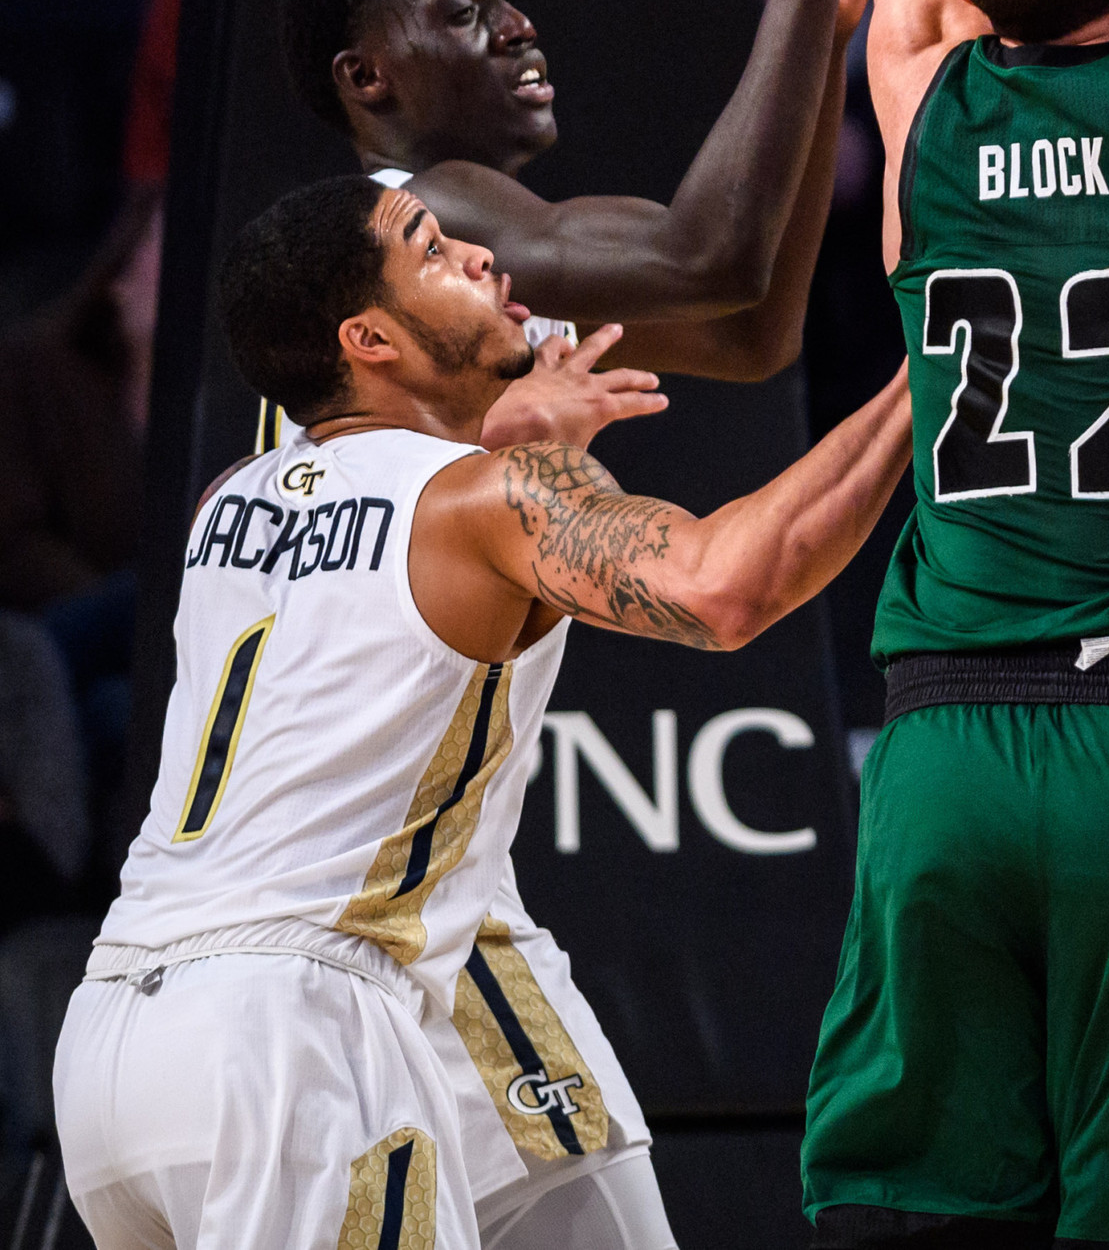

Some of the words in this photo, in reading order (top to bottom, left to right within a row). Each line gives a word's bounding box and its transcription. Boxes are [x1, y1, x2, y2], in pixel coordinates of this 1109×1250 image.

[978, 137, 1109, 201] BLOCK
[282, 460, 325, 497] GT
[186, 494, 396, 581] JACKSON
[172, 612, 277, 844] 1
[526, 707, 818, 855] NC
[506, 1069, 584, 1117] GT
